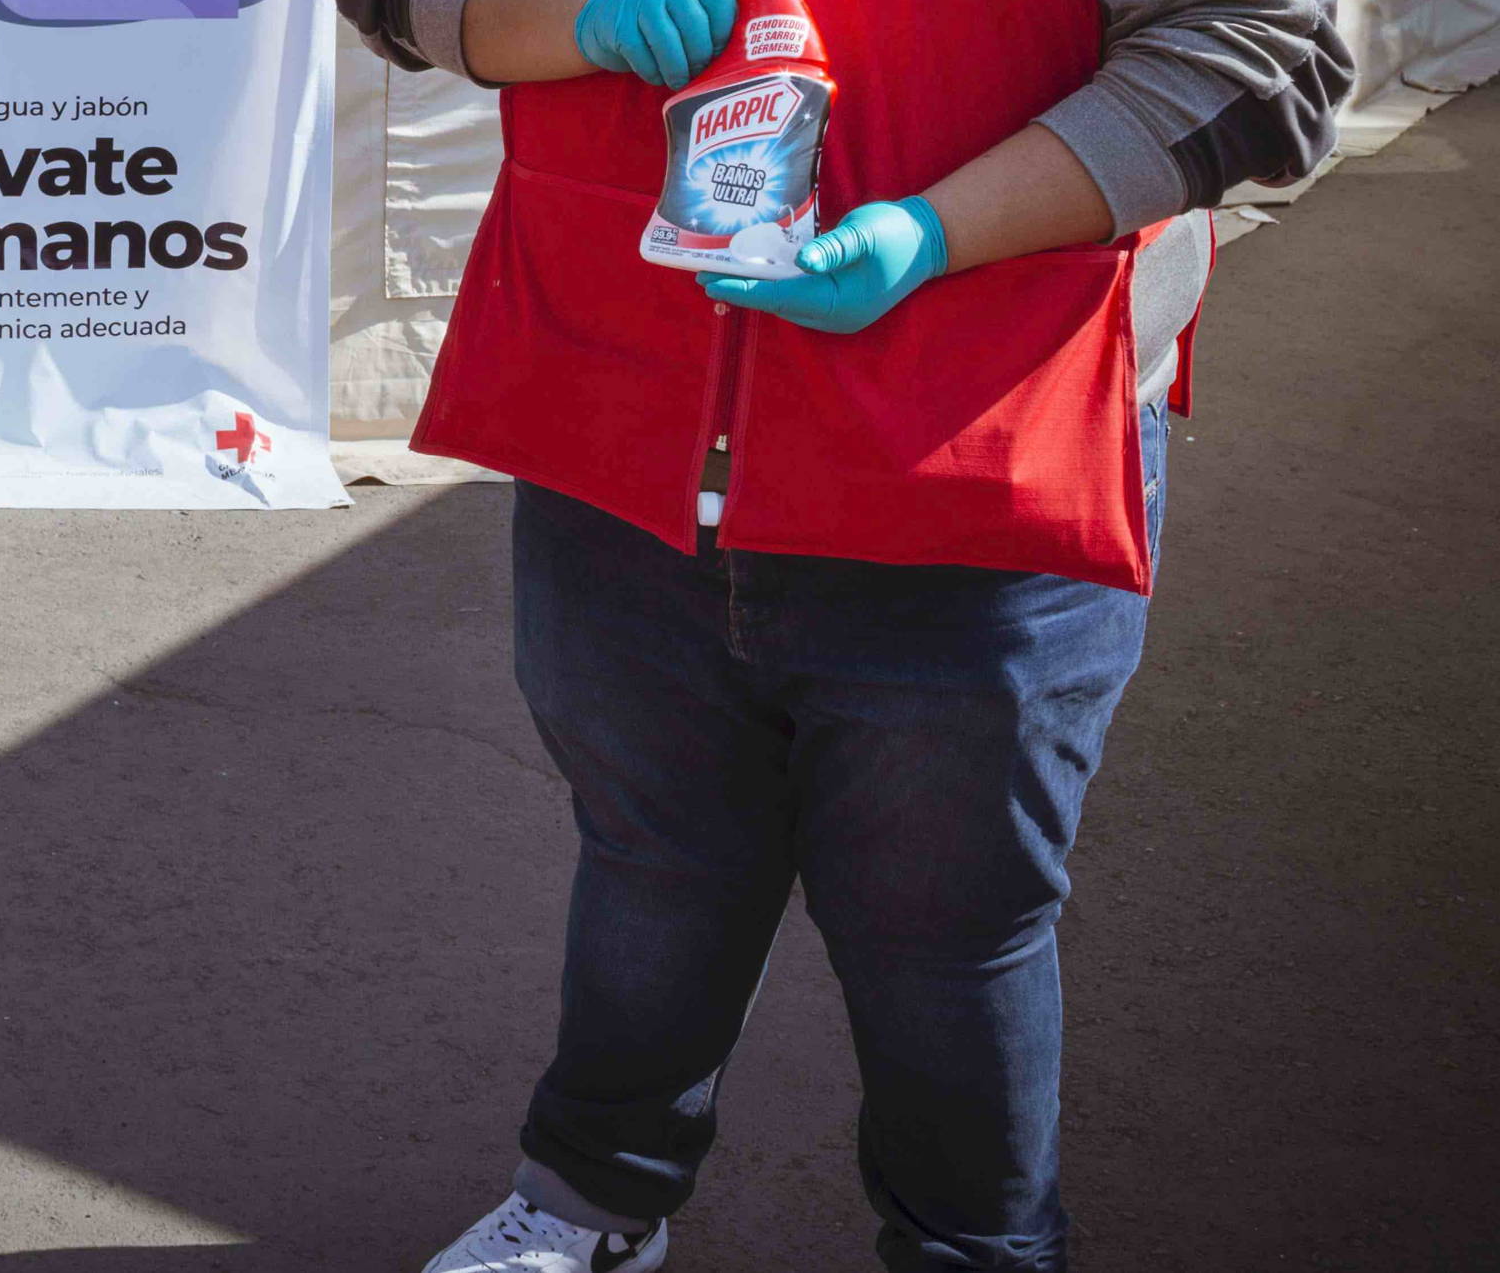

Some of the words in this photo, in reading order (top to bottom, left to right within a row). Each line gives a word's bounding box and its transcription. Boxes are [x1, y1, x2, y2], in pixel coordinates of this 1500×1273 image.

[750, 33, 763, 44] DE
[764, 31, 796, 42] SARRO
[51, 100, 68, 121] y
[71, 96, 149, 121] jabón
[694, 90, 785, 146] HARPIC
[712, 163, 766, 191] BAÑOS
[714, 183, 758, 207] ULTRA
[134, 288, 150, 310] y
[60, 315, 187, 339] adecuada
